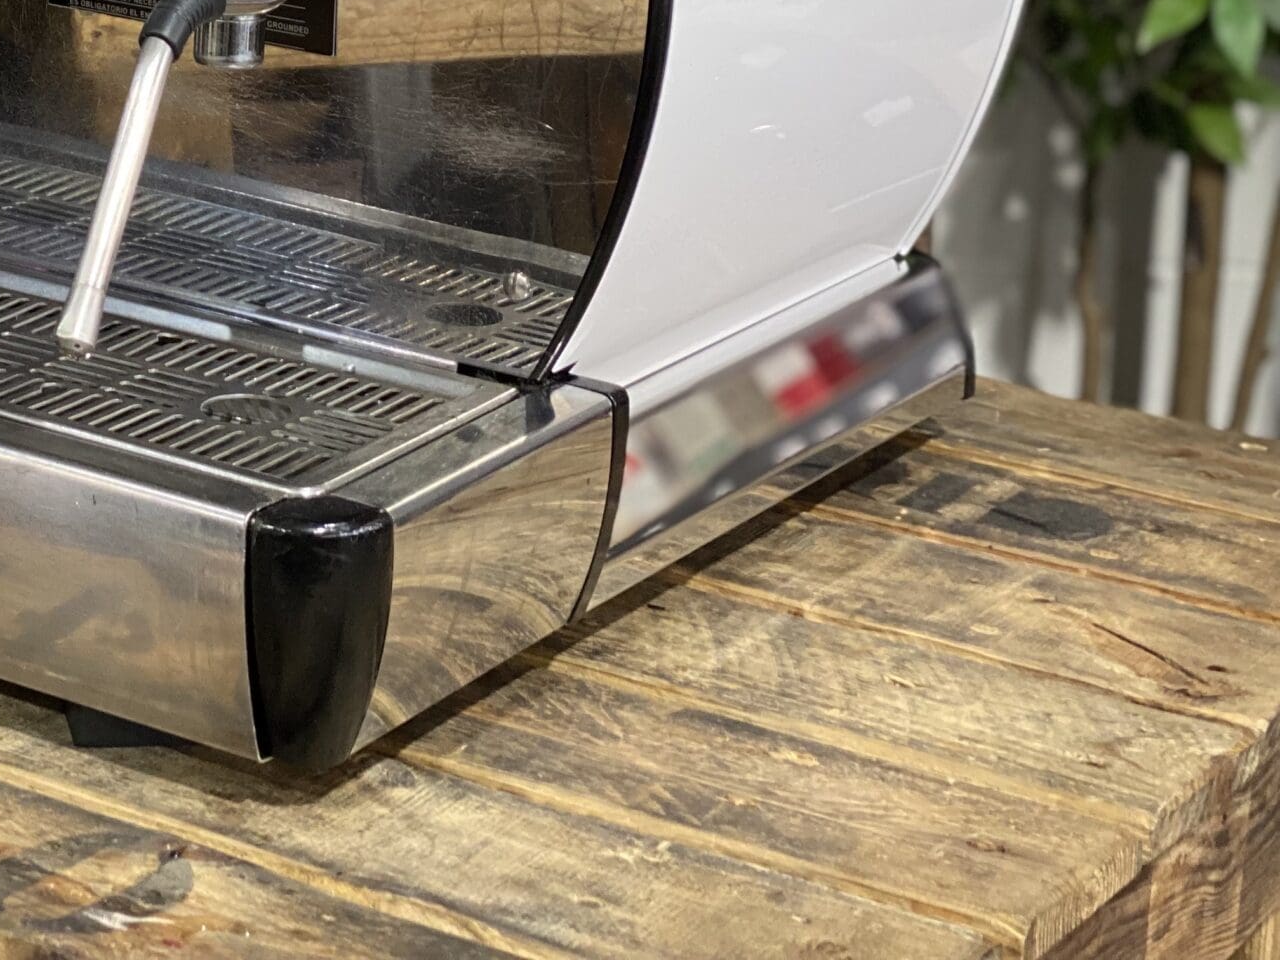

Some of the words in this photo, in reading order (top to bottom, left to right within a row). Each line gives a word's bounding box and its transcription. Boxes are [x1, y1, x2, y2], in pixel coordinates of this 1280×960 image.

[80, 0, 128, 14] OBLIGATORIO
[129, 8, 138, 17] EL
[267, 20, 309, 35] GROUNDED
